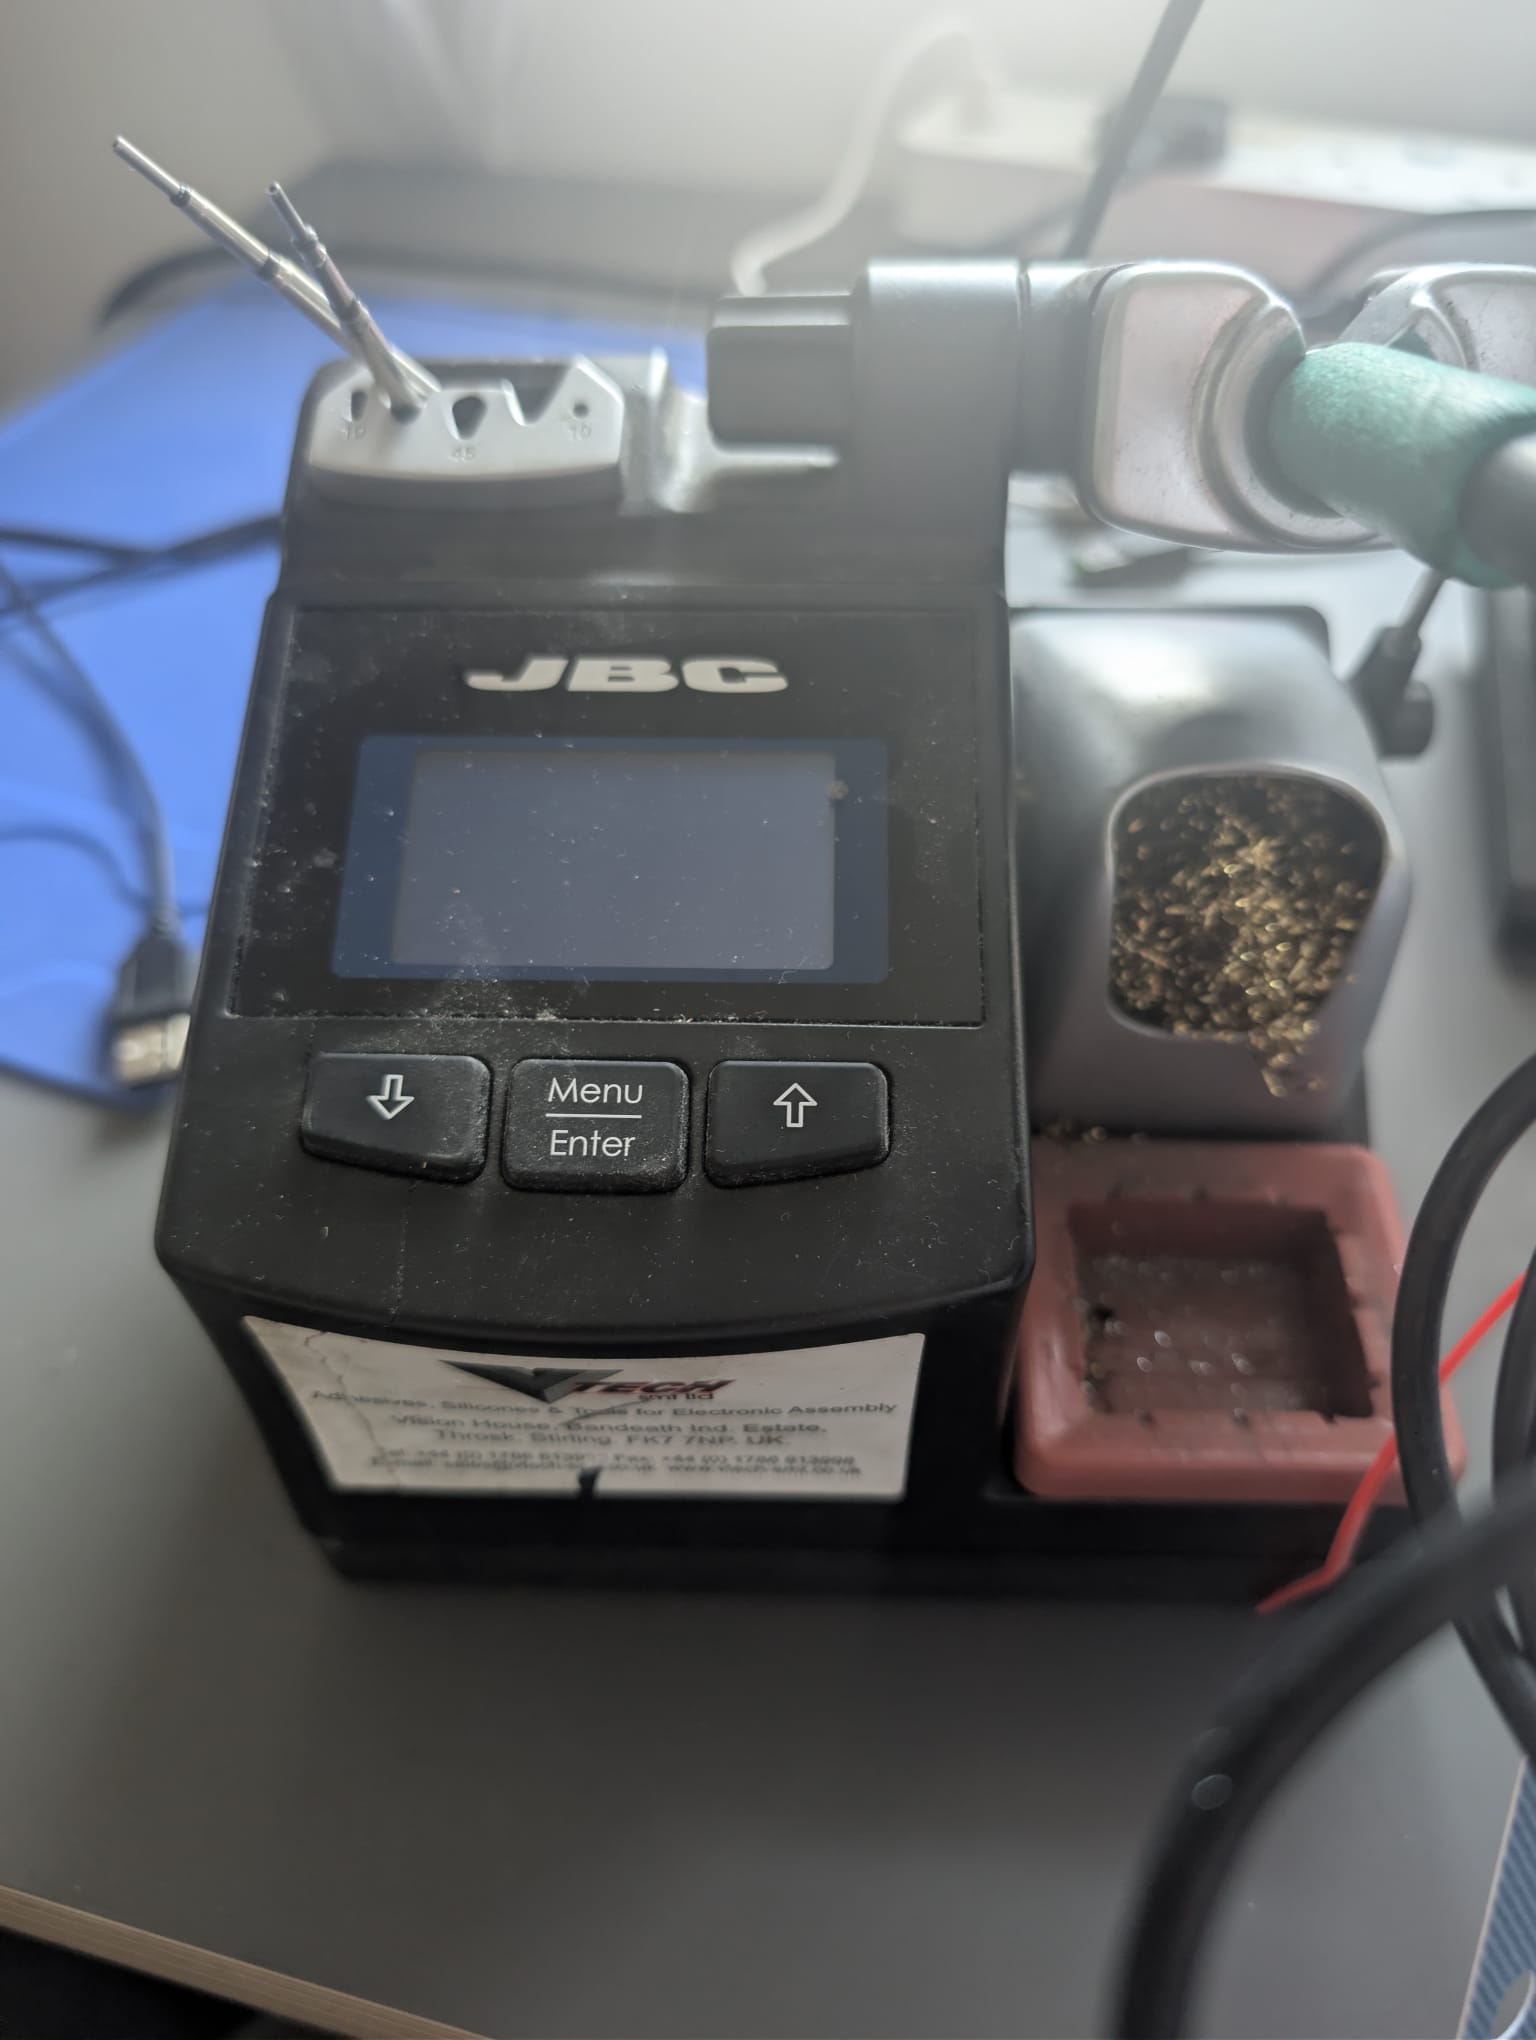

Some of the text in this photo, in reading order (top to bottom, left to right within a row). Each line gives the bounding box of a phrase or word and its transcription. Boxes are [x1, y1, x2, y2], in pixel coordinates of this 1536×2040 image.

[464, 655, 789, 694] JBC
[547, 1077, 643, 1104] Menu
[550, 1129, 636, 1157] Enter
[440, 1400, 540, 1413] Silicones
[548, 1406, 563, 1414] &
[636, 1407, 668, 1416] for
[671, 1405, 783, 1416] Electronic
[787, 1402, 897, 1415] Assembly
[391, 1414, 465, 1427] Vision
[628, 1434, 673, 1446] FK7
